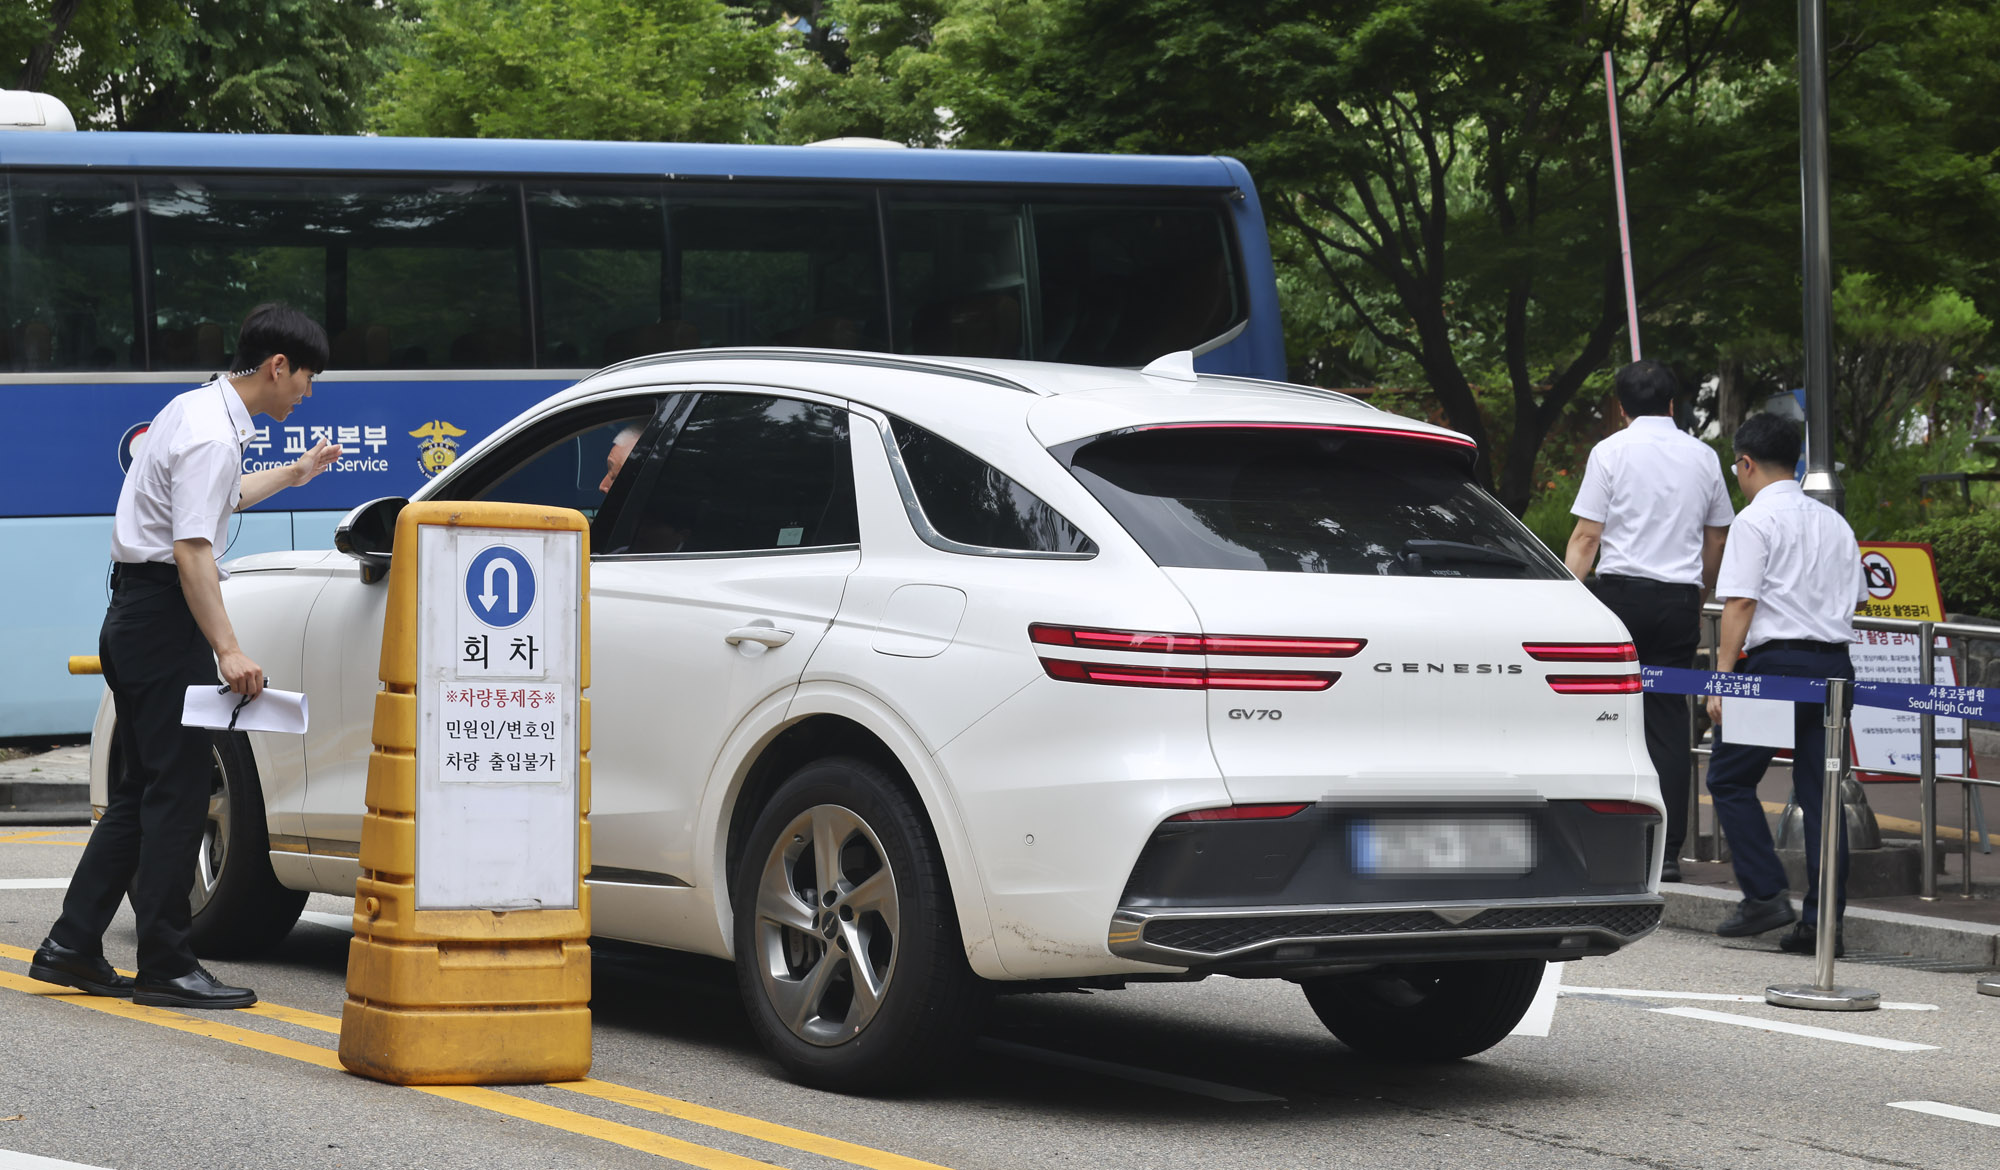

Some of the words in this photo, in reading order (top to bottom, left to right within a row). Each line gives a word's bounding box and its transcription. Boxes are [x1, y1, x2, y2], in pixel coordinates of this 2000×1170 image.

[335, 456, 388, 472] Service
[1893, 604, 1930, 617] 촬영금지
[1373, 663, 1523, 674] GENESIS
[1704, 680, 1760, 696] 서울고등법원
[1928, 687, 1985, 702] 서울고등법원
[1228, 708, 1282, 721] GV70
[1908, 697, 1933, 710] Seoul
[1934, 700, 1956, 715] High
[1957, 703, 1983, 716] Court
[446, 720, 555, 739] 민원인/변호인
[446, 751, 480, 771] 차량
[489, 752, 556, 771] 출입불가
